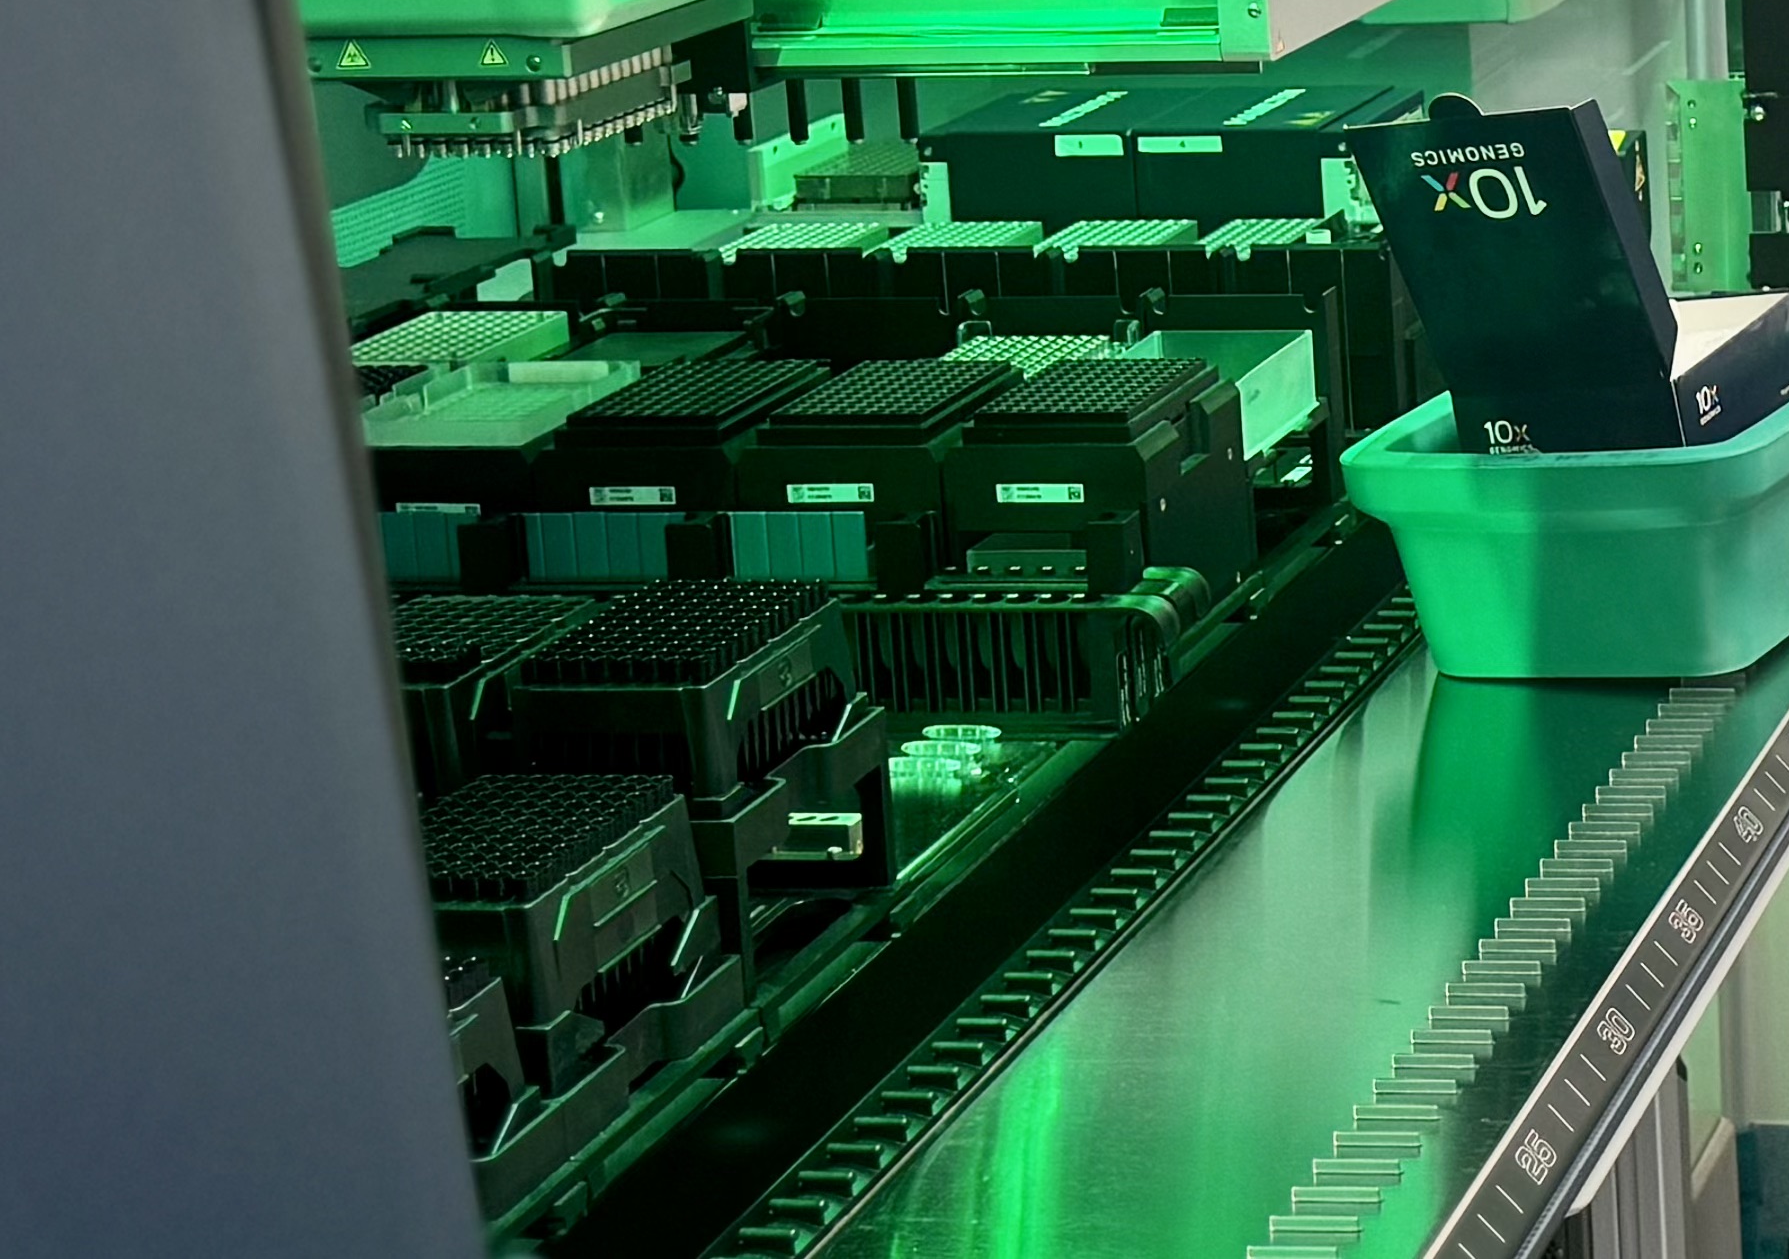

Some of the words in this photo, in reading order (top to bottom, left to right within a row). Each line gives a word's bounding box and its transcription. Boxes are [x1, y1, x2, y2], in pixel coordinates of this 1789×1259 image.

[1410, 142, 1525, 167] GENOMICS
[1733, 805, 1764, 844] 40
[1667, 898, 1705, 944] 35
[1596, 1007, 1636, 1056] 30
[1514, 1128, 1558, 1186] 25
